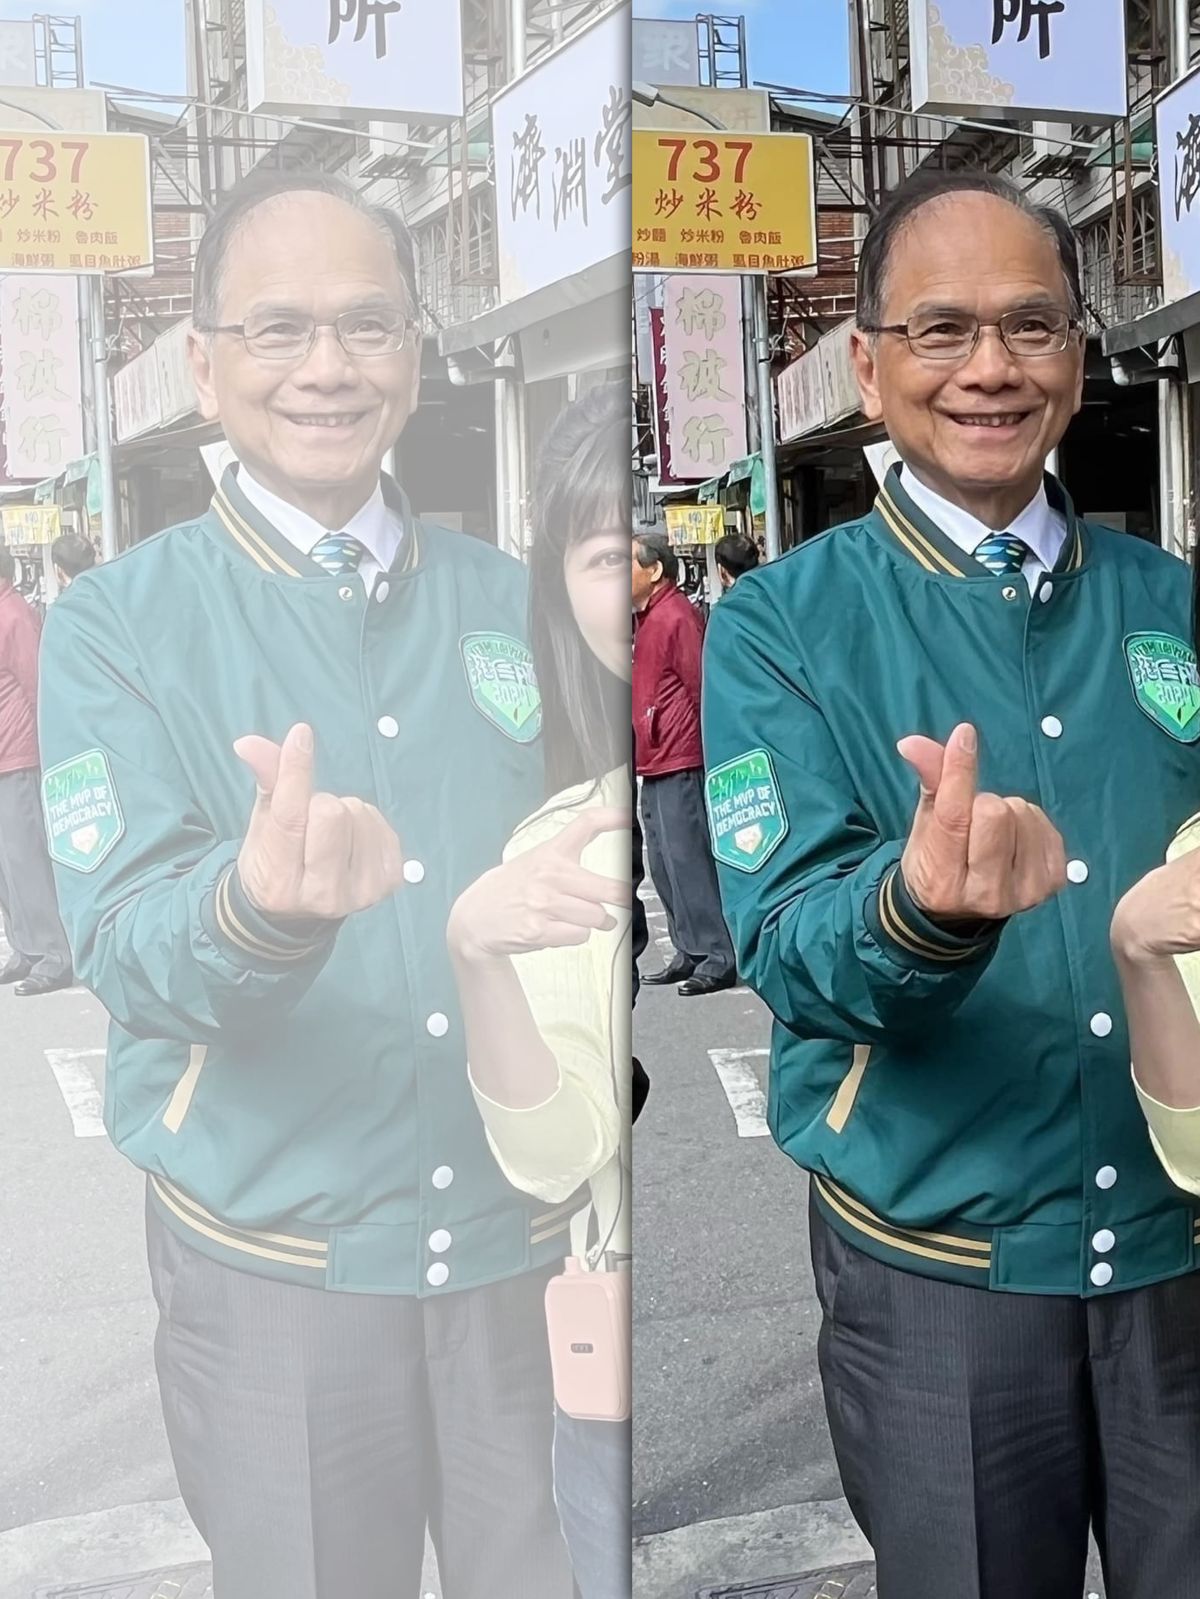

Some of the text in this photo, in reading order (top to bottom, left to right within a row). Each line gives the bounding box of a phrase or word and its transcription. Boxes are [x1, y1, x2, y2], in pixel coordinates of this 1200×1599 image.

[0, 139, 89, 183] 737
[658, 139, 752, 183] 737
[654, 187, 763, 221] 炒米粉
[680, 228, 724, 244] 炒米粉
[675, 287, 736, 466] 棉被行
[49, 785, 107, 820] THE MVP OF
[52, 801, 112, 837] DEMOCRACY
[713, 785, 771, 820] THE MVP OF
[716, 801, 776, 837] DEMOCRACY
